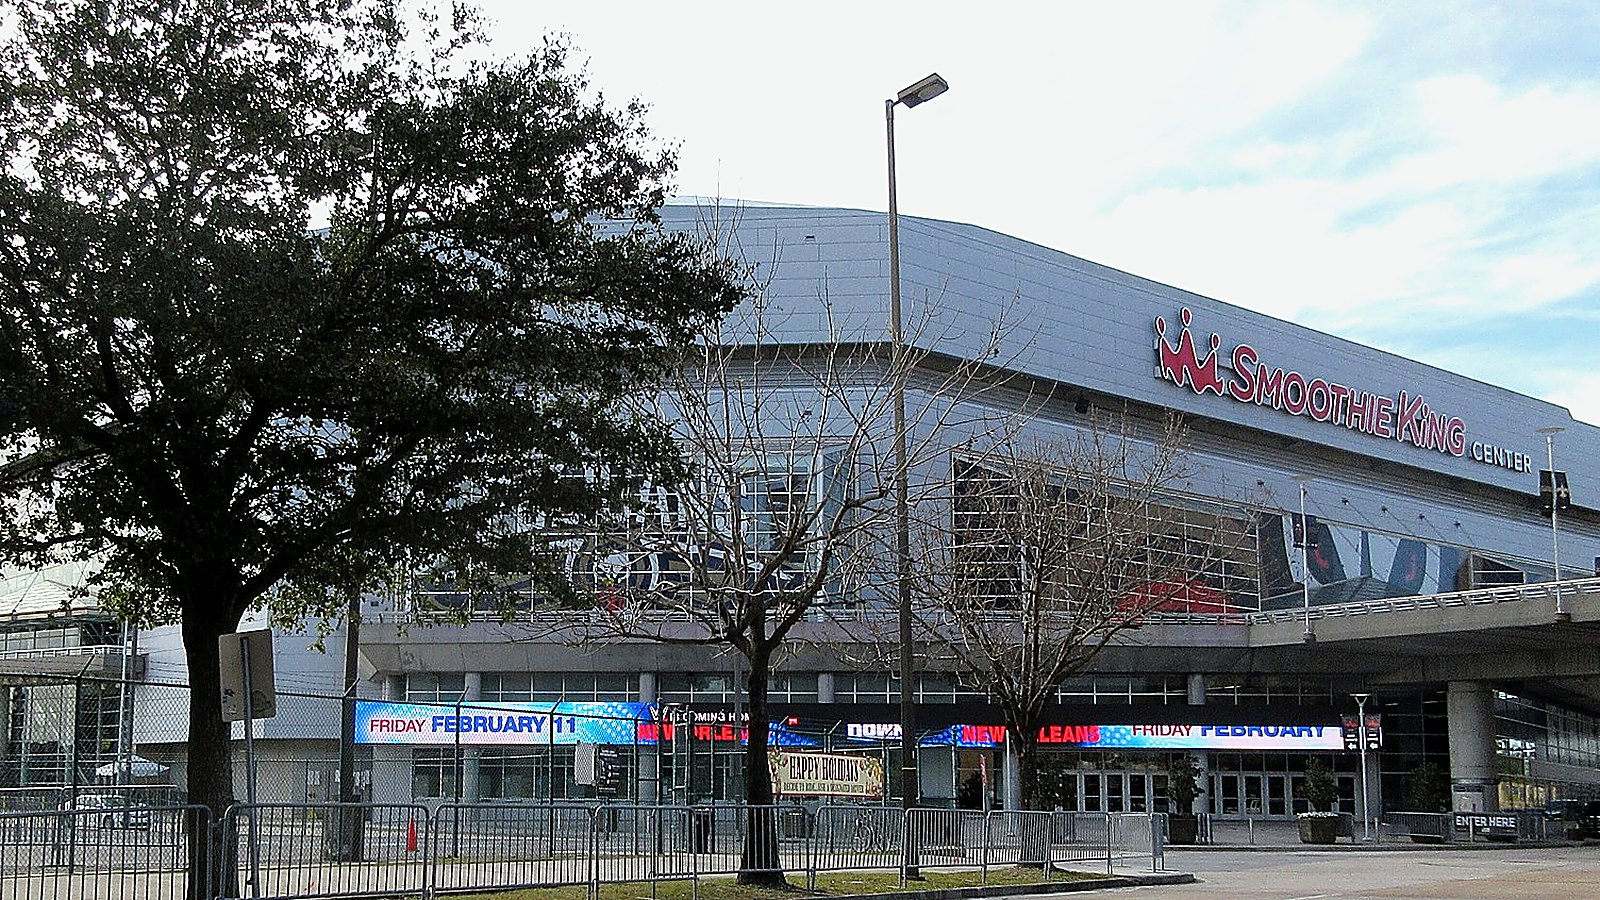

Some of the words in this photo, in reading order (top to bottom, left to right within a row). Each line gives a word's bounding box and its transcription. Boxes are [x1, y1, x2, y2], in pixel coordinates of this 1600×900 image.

[1228, 344, 1393, 438] SMOOTHIE
[1471, 440, 1532, 474] CENTER
[370, 719, 426, 733] FRIDAY
[431, 715, 546, 734] FEBRUARY
[553, 716, 576, 733] 11
[962, 725, 1006, 743] NEW
[1037, 725, 1102, 743] LEANS
[1132, 726, 1192, 738] FRIDAY
[1201, 726, 1324, 738] FEBRUARY
[789, 756, 820, 780] HAPPY
[821, 758, 860, 782] HOLIDAYS
[1456, 815, 1488, 827] ENTER
[1488, 816, 1516, 828] HERE
